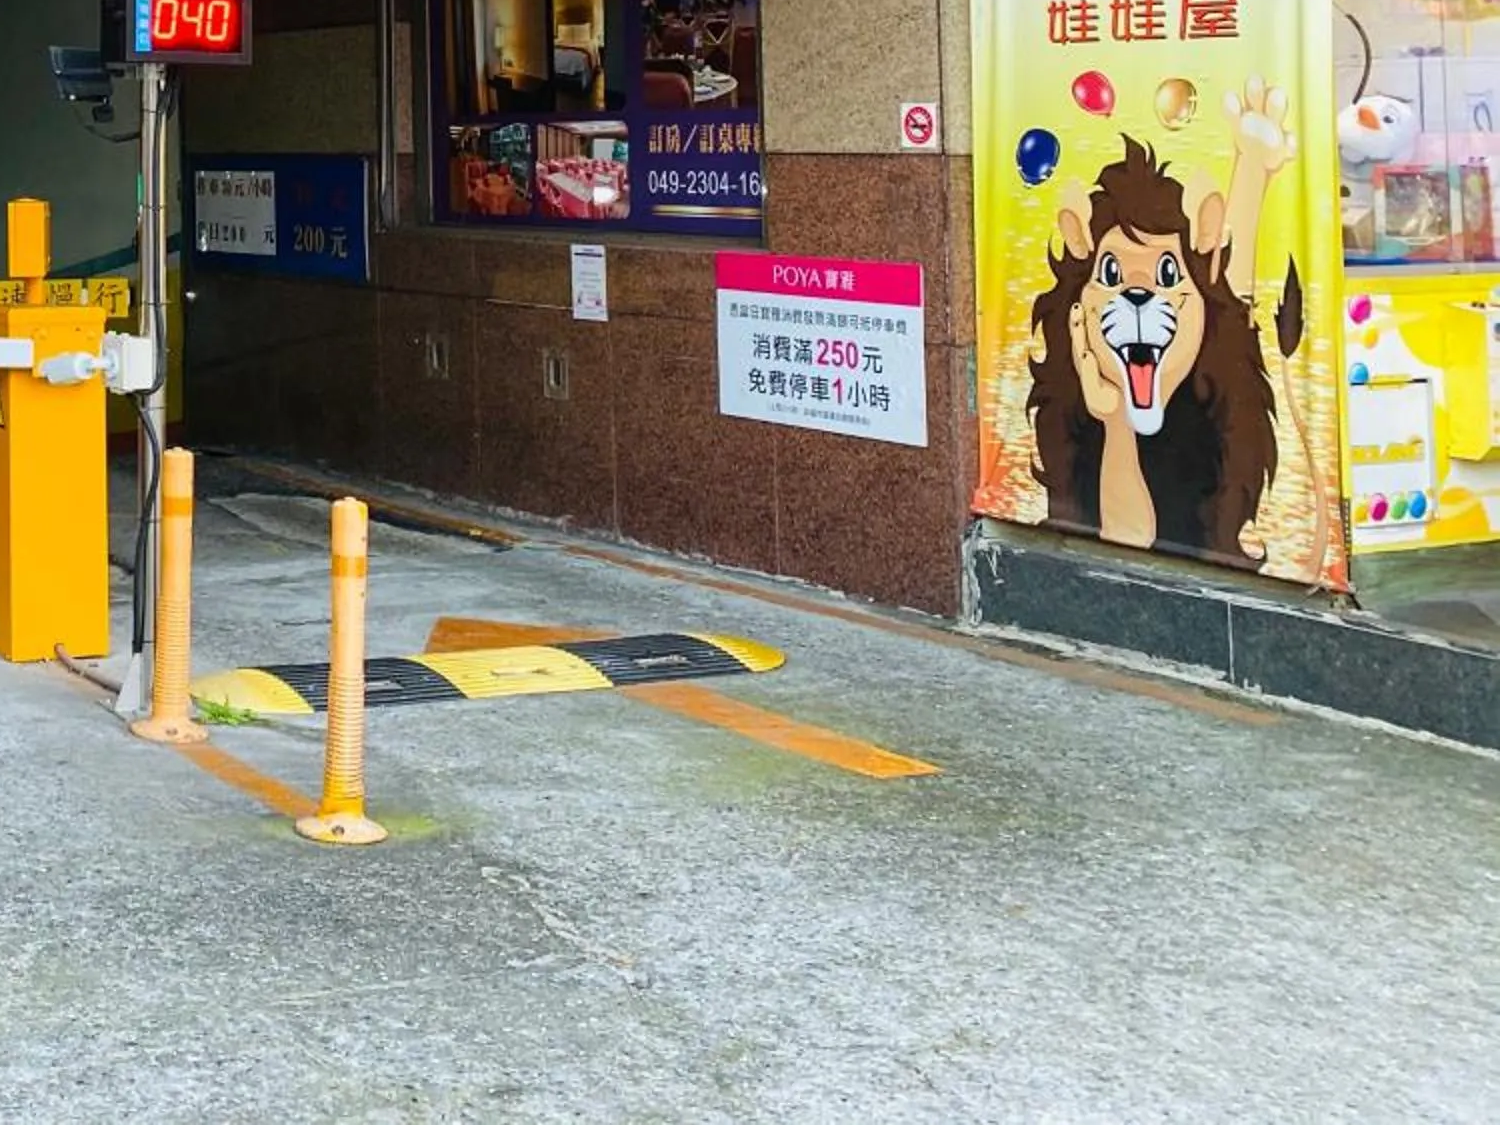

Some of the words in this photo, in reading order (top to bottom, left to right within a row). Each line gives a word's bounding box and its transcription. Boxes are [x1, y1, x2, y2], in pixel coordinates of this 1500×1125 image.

[647, 169, 761, 196] 049-2304-16
[773, 264, 821, 288] POYA
[752, 332, 884, 374] 消費滿250元
[748, 367, 891, 412] 免費停車1小時
